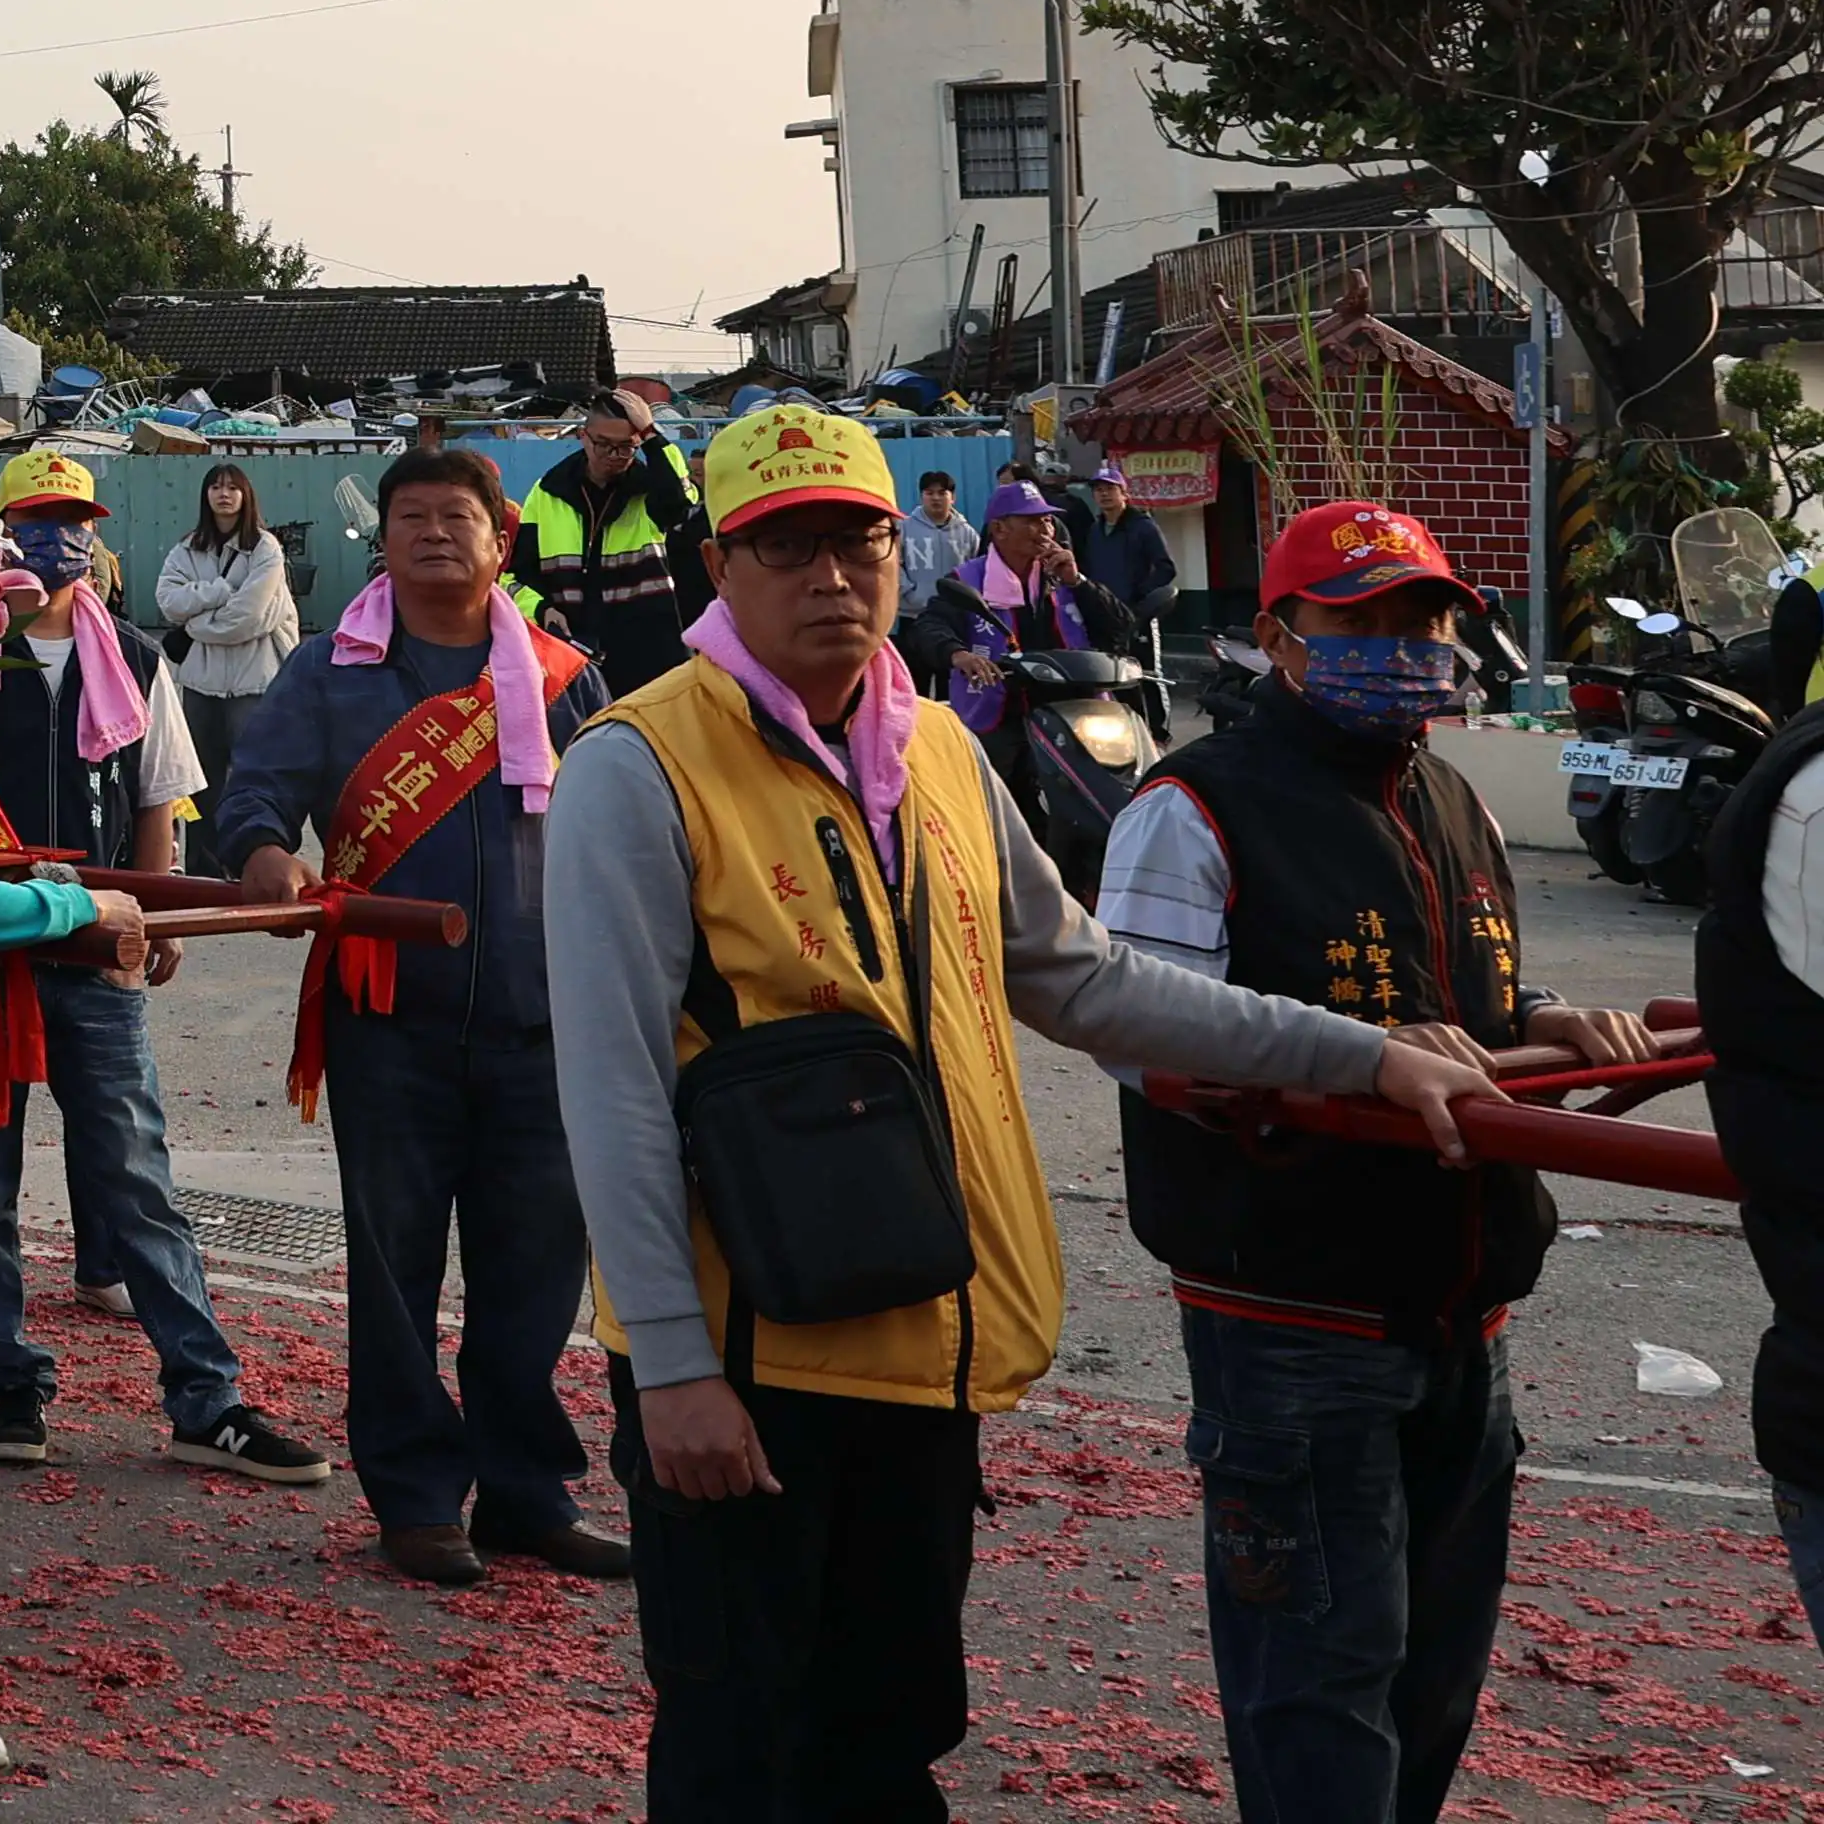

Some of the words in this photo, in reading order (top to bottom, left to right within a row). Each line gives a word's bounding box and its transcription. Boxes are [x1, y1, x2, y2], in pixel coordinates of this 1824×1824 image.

[760, 462, 845, 484] 包青天祖廟
[440, 702, 498, 772] 國聖宮
[1613, 764, 1683, 784] 651-JUZ
